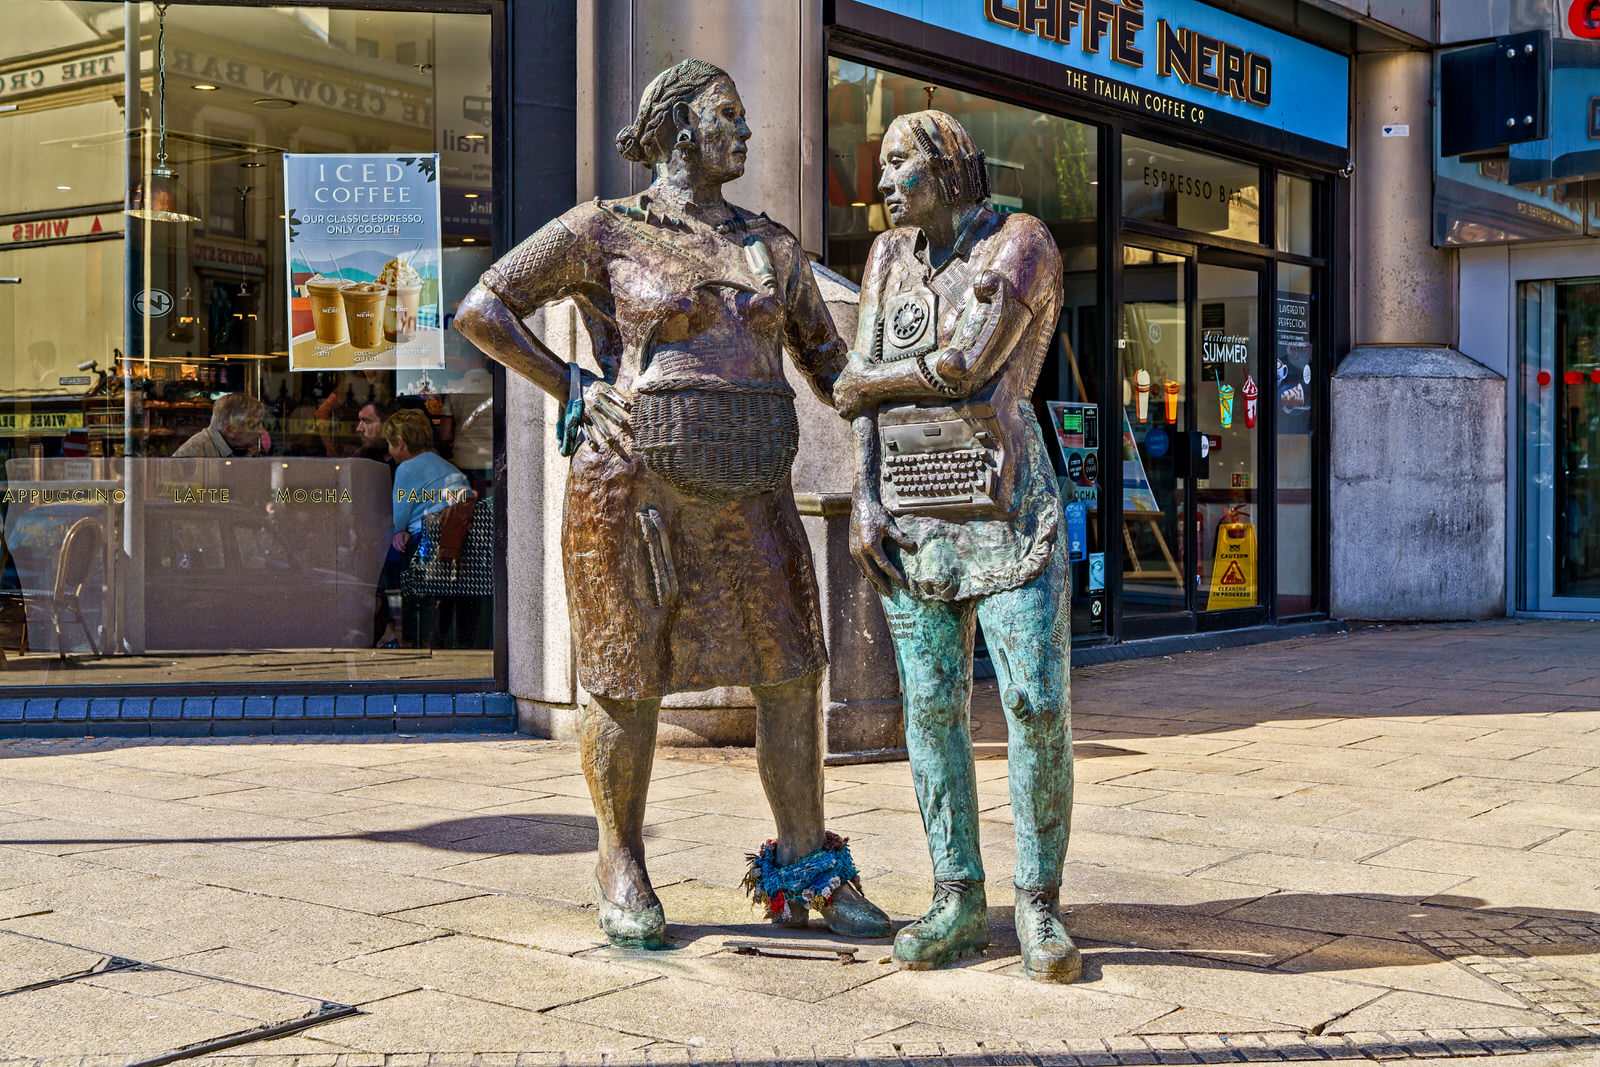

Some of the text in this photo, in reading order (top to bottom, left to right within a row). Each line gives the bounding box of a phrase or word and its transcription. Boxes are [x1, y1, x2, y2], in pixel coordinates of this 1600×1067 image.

[1157, 18, 1272, 107] NERO
[1066, 70, 1088, 92] THE
[1094, 79, 1139, 106] ITALIAN
[1145, 95, 1186, 120] COFFEE
[320, 163, 404, 183] ICED
[314, 187, 411, 203] COFFEE
[1144, 167, 1243, 208] ESPRESSO BAR
[302, 214, 424, 225] OUR CLASSIC ESPRESSO,
[326, 225, 400, 234] ONLY COOLER
[1204, 330, 1247, 344] destination
[1203, 342, 1248, 364] SUMMER
[2, 488, 127, 503] APPUCCINO
[174, 488, 230, 503] LATTE
[276, 488, 352, 503] MOCHA
[397, 488, 468, 503] PANINI
